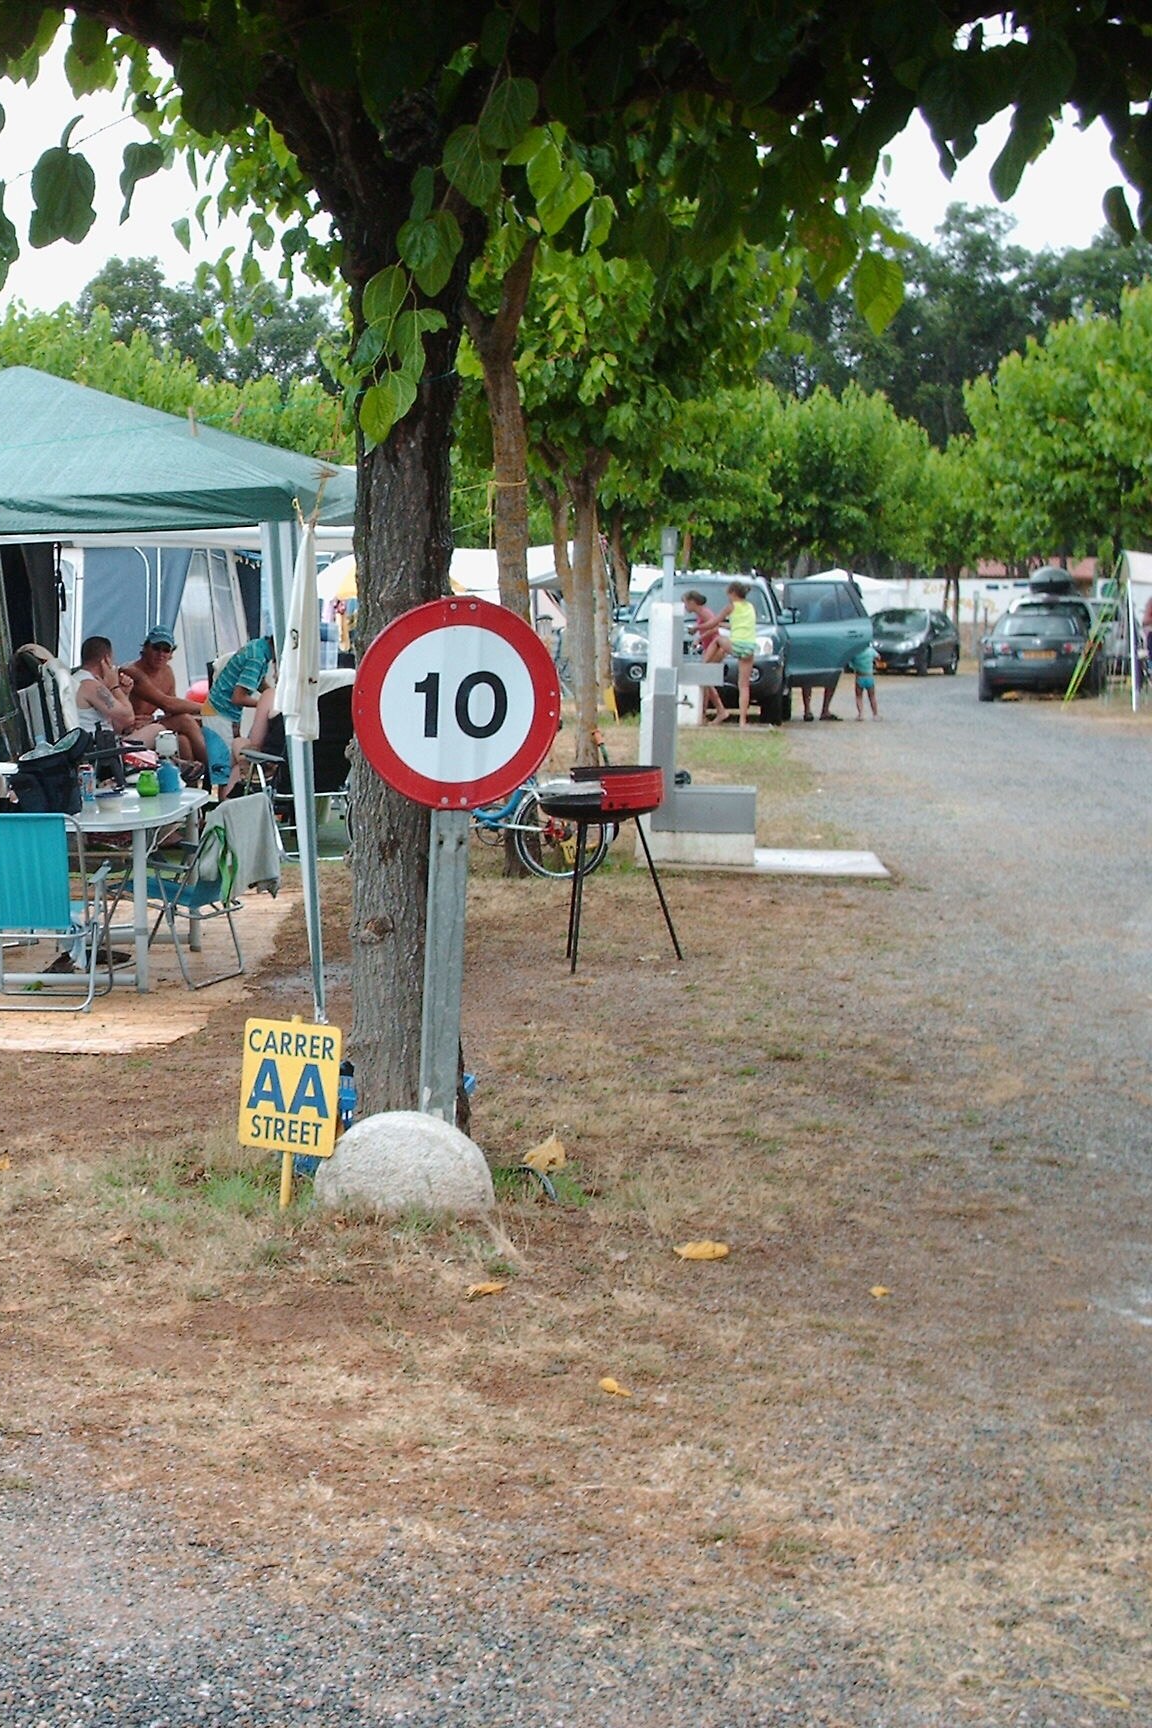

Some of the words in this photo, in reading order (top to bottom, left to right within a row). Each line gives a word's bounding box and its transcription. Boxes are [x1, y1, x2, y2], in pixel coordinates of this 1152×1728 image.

[414, 671, 508, 739] 10
[249, 1028, 335, 1061] CARRER
[246, 1058, 329, 1119] AA
[251, 1114, 323, 1147] STREET
